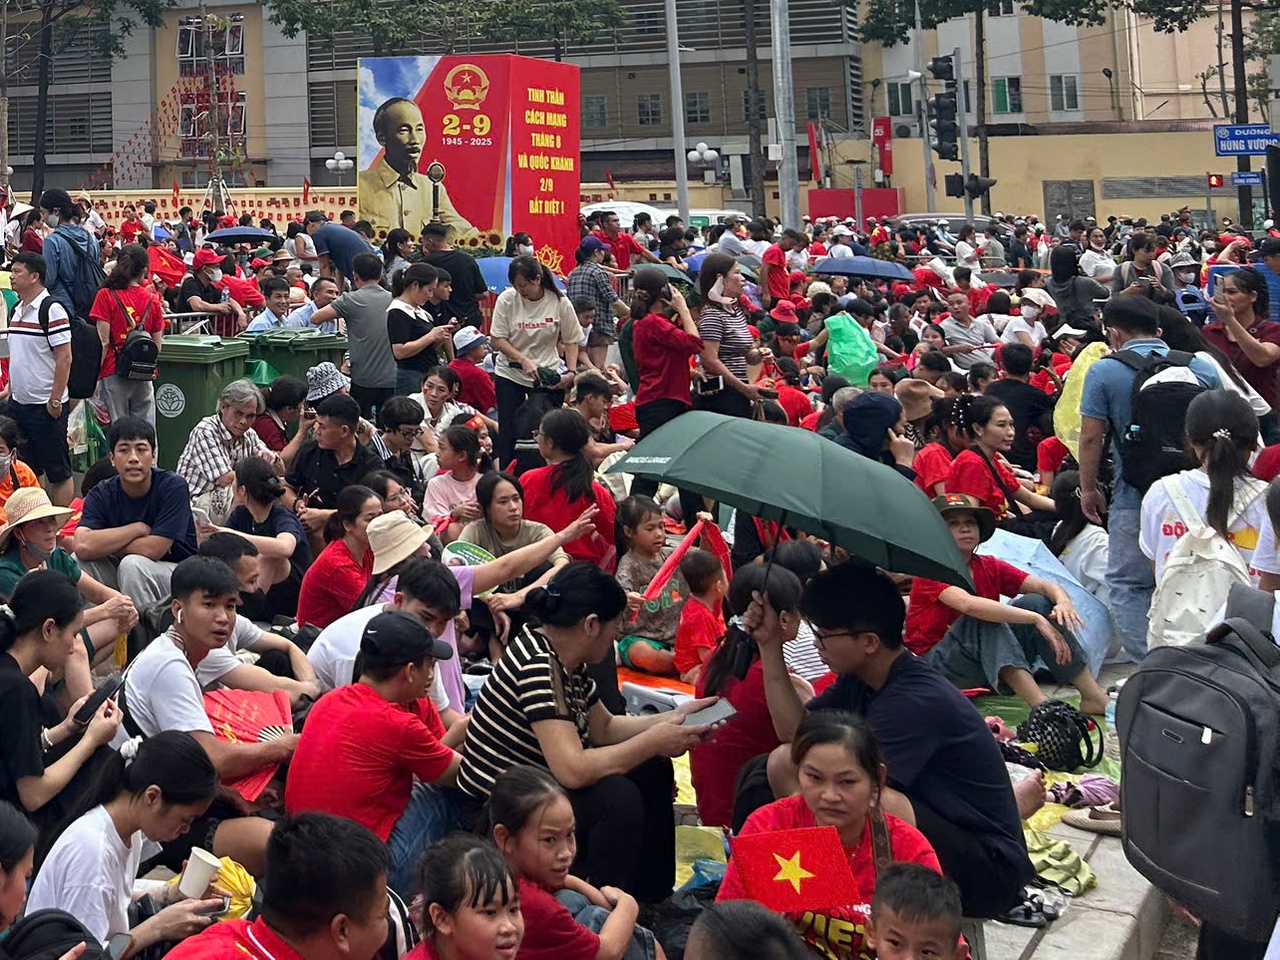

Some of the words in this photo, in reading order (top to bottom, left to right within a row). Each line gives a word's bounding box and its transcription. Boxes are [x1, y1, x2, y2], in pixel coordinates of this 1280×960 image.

[442, 114, 491, 136] 2-9
[442, 137, 462, 145] 1945
[470, 137, 492, 146] 2025
[556, 135, 561, 149] 8
[540, 178, 553, 192] 2/9
[1162, 521, 1189, 540] ĐỘ
